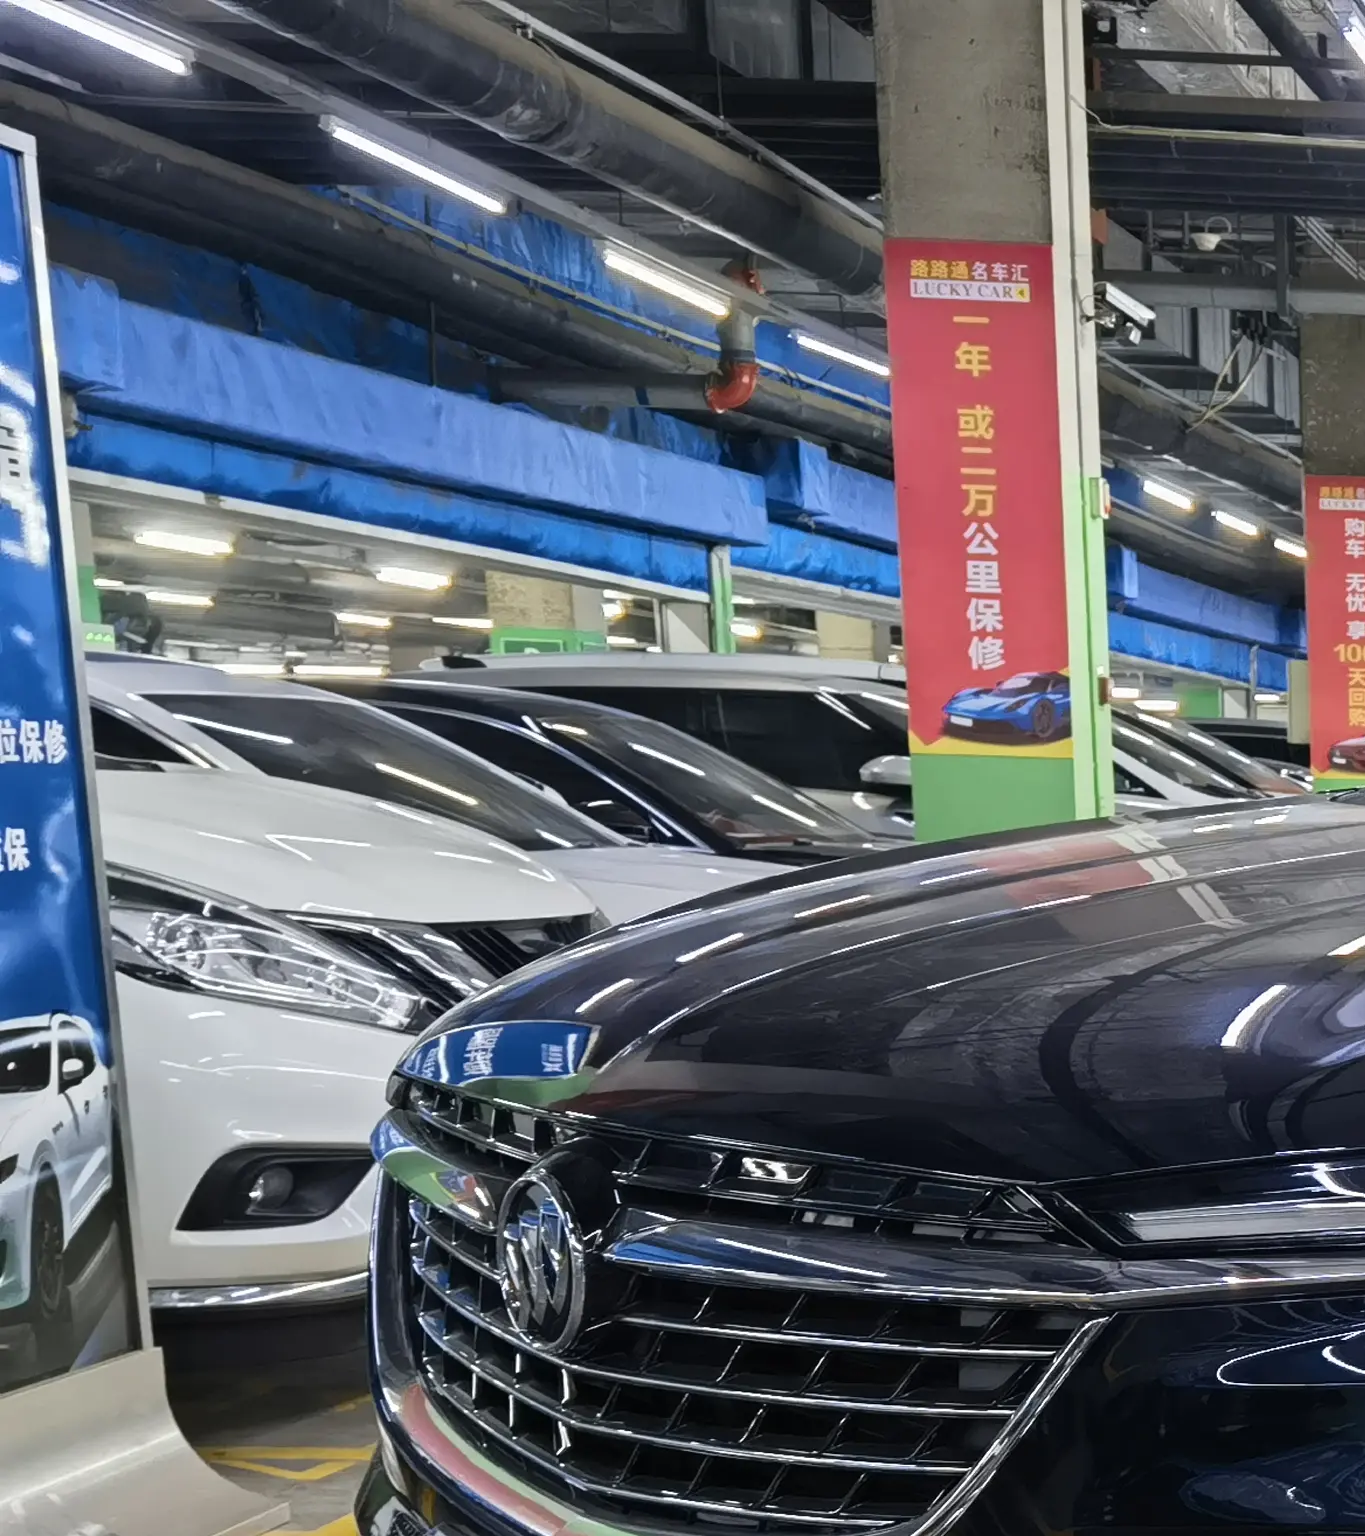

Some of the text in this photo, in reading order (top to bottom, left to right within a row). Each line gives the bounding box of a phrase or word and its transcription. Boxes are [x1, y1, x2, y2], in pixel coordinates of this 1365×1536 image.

[910, 260, 1028, 281] 路路通名车汇
[913, 282, 1013, 298] LUCKY CAR
[0, 827, 31, 871] 保
